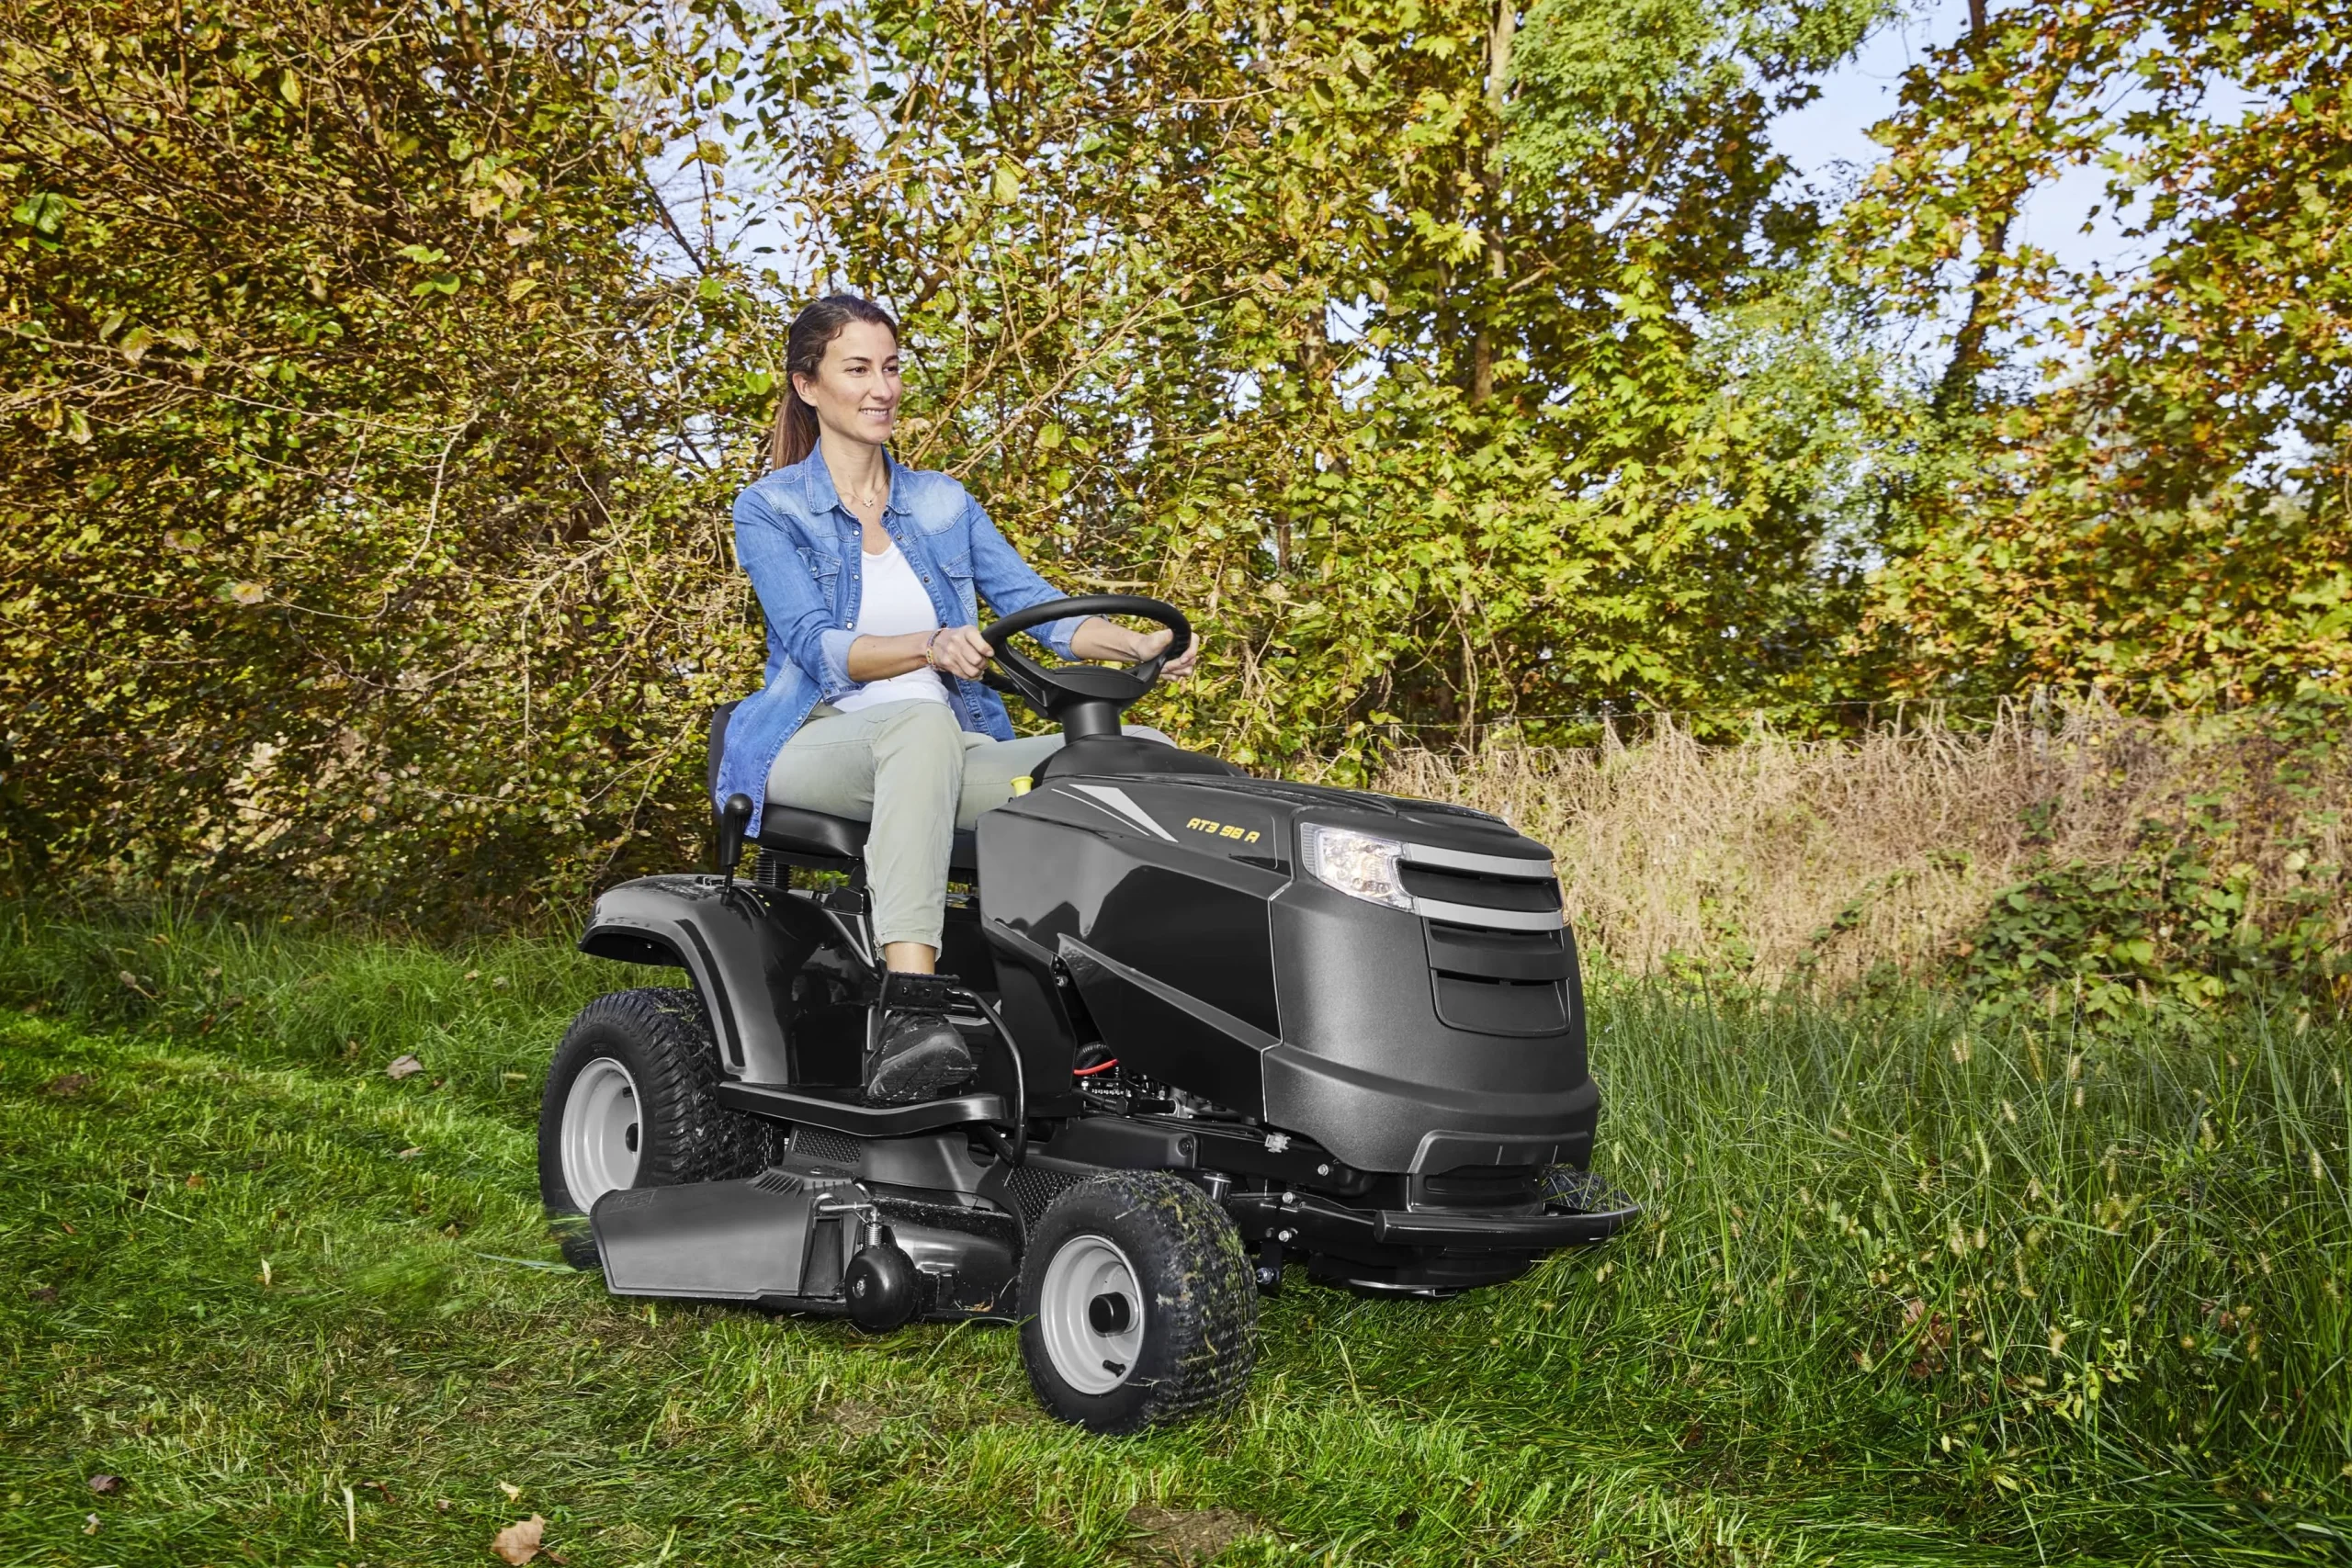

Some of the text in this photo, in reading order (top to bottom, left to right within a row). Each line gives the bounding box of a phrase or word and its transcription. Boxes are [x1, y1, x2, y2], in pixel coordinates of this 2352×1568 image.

[1186, 818, 1261, 843] AT3 98 A
